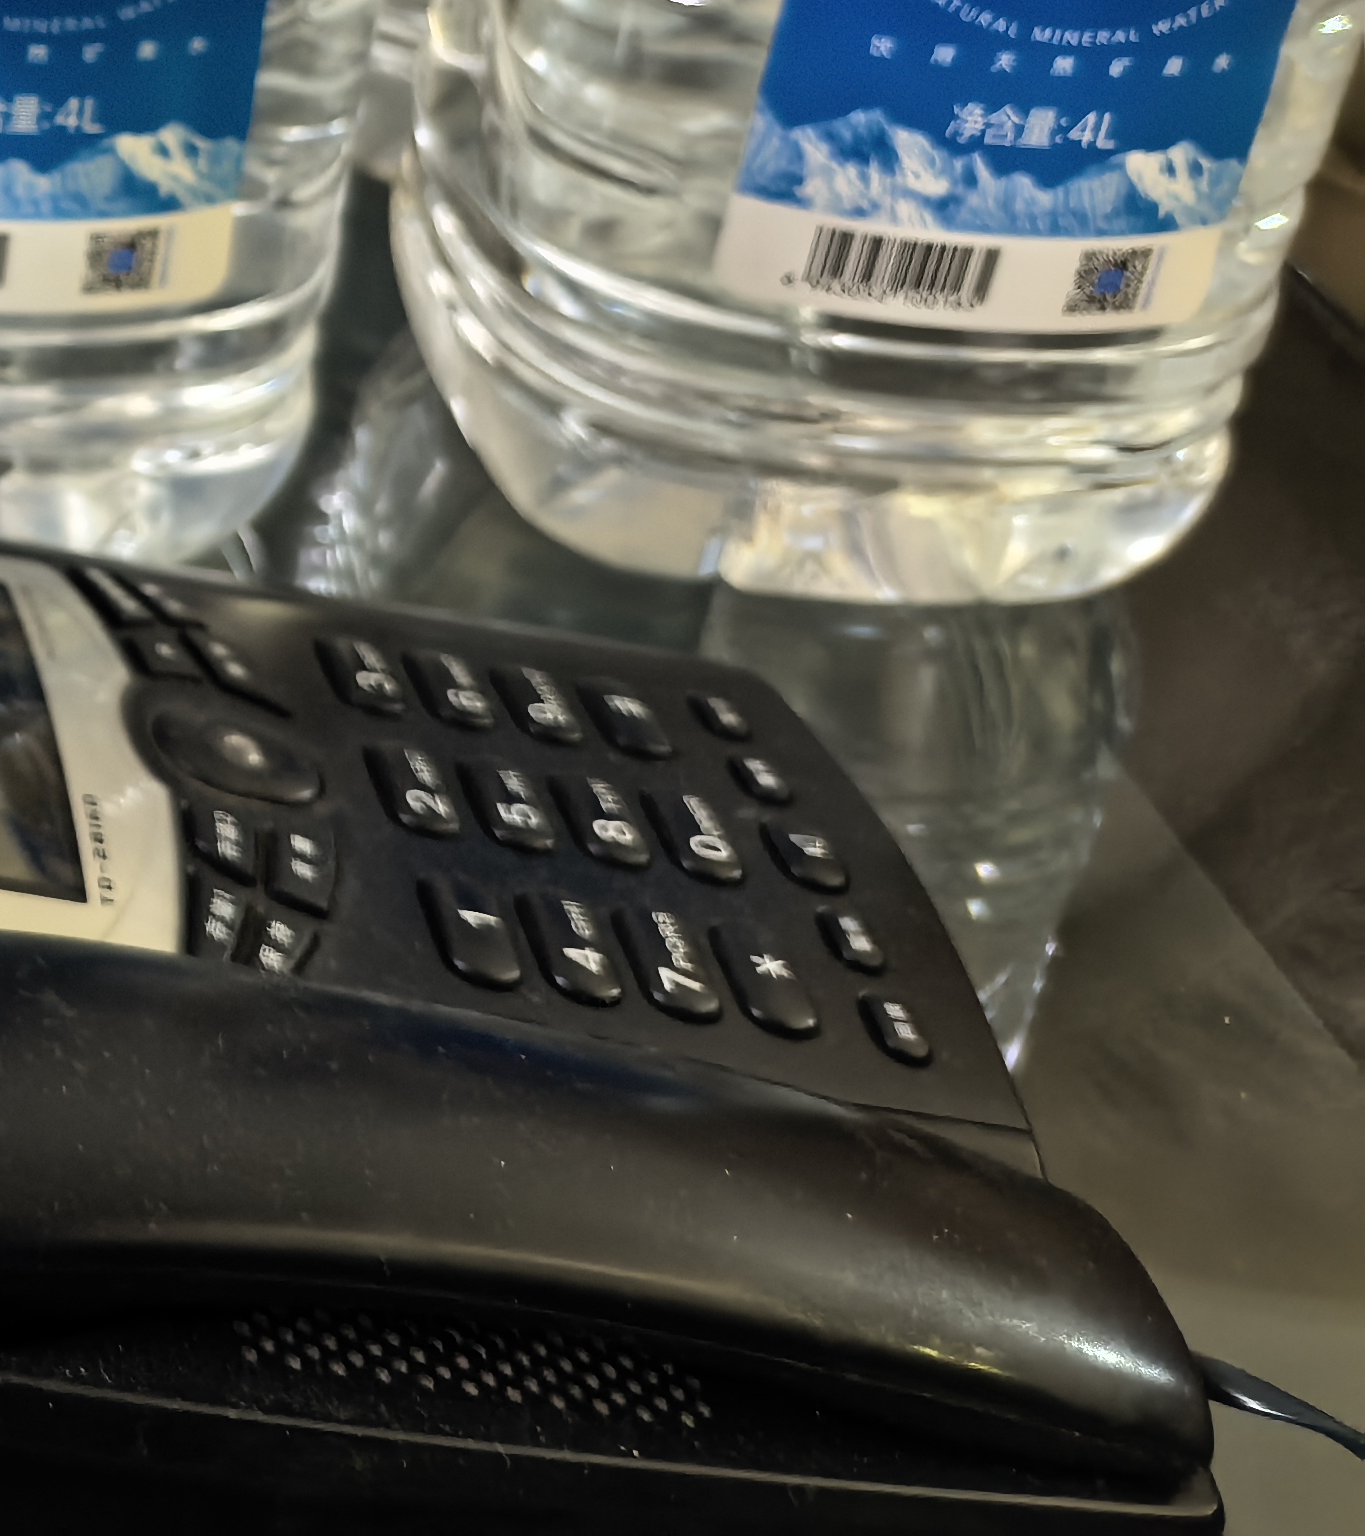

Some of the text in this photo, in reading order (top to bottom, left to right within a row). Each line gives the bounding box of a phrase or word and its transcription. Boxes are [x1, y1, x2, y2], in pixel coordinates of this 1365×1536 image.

[405, 789, 450, 819] 2
[496, 801, 544, 828] 5
[591, 818, 636, 845] 8
[689, 834, 732, 861] 0
